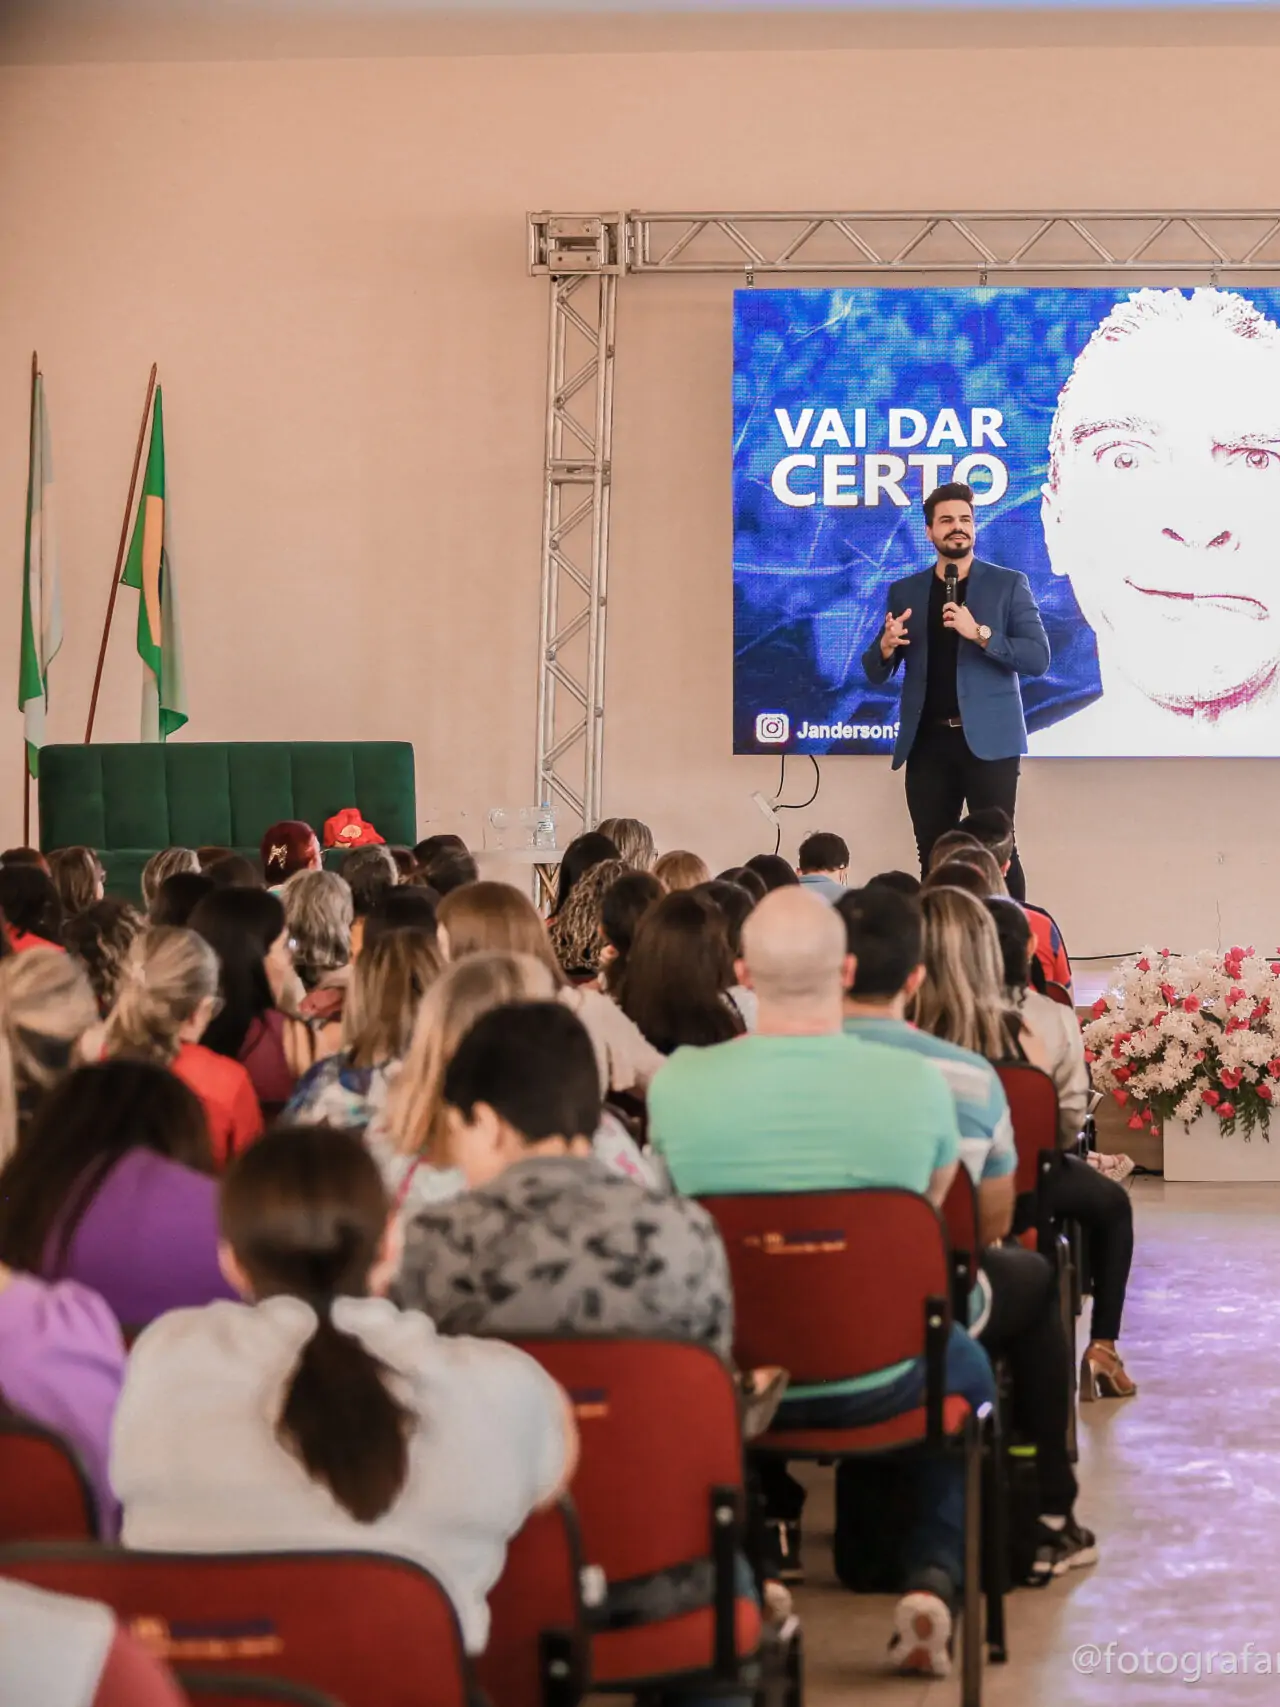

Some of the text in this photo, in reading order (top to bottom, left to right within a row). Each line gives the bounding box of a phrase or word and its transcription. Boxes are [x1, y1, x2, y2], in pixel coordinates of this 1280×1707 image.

[774, 408, 1008, 448] VAI DAR
[771, 452, 1009, 507] CERTO
